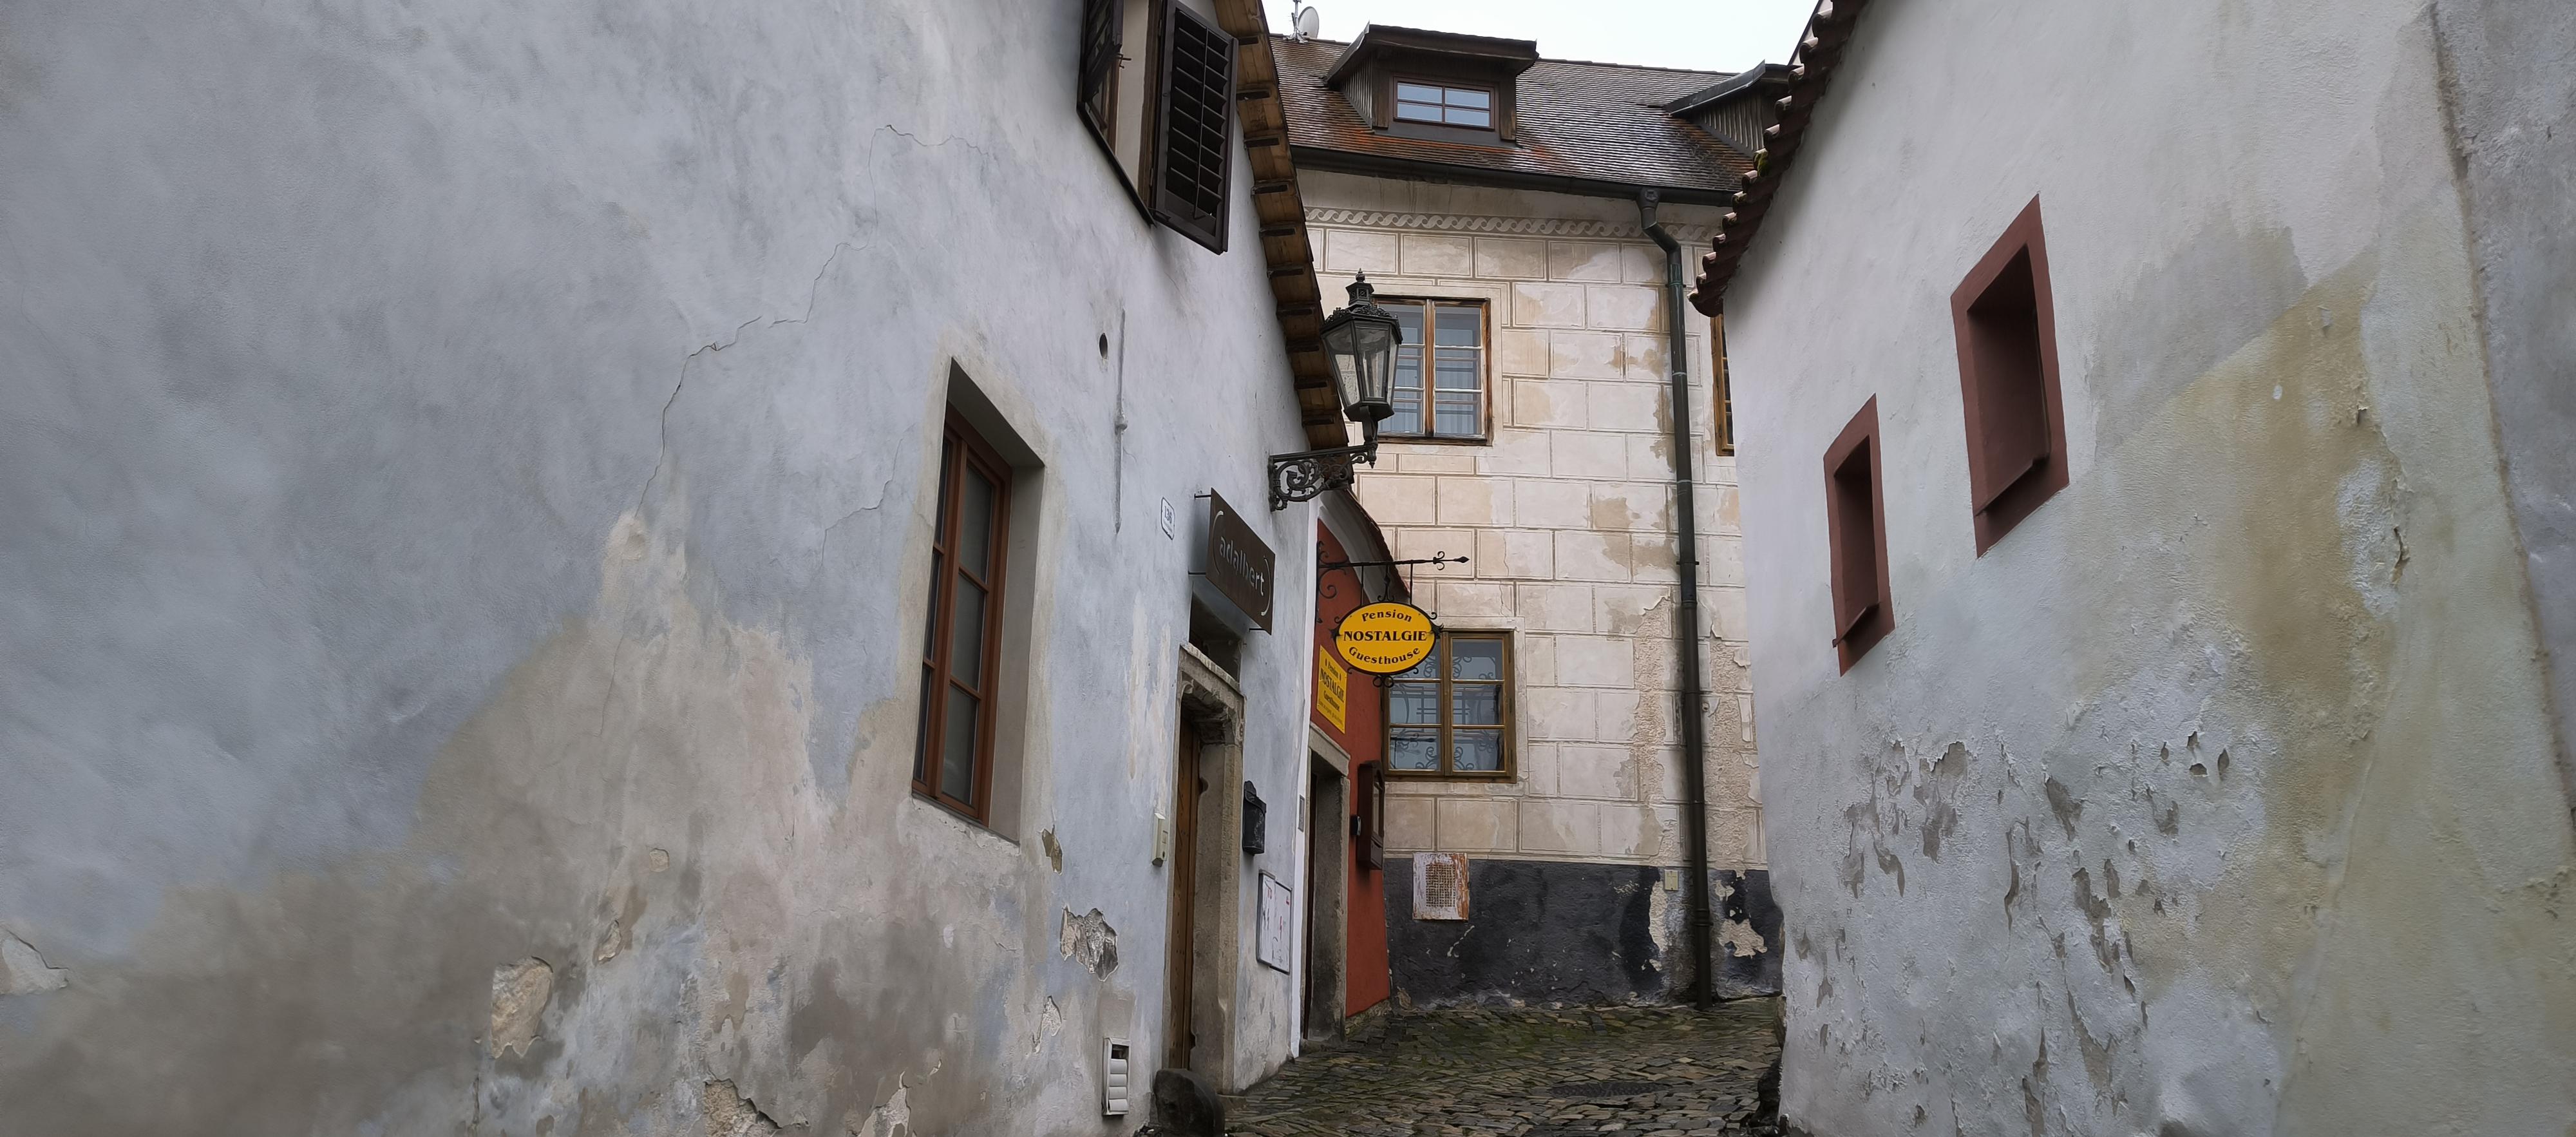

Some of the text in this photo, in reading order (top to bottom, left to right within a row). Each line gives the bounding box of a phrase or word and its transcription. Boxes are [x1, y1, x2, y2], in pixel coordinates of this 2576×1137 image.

[1362, 609, 1412, 622] Pension
[1344, 631, 1427, 641] NOSTALGIE
[1349, 647, 1420, 664] Guesthouse
[1320, 668, 1344, 703] NOSTALGIE
